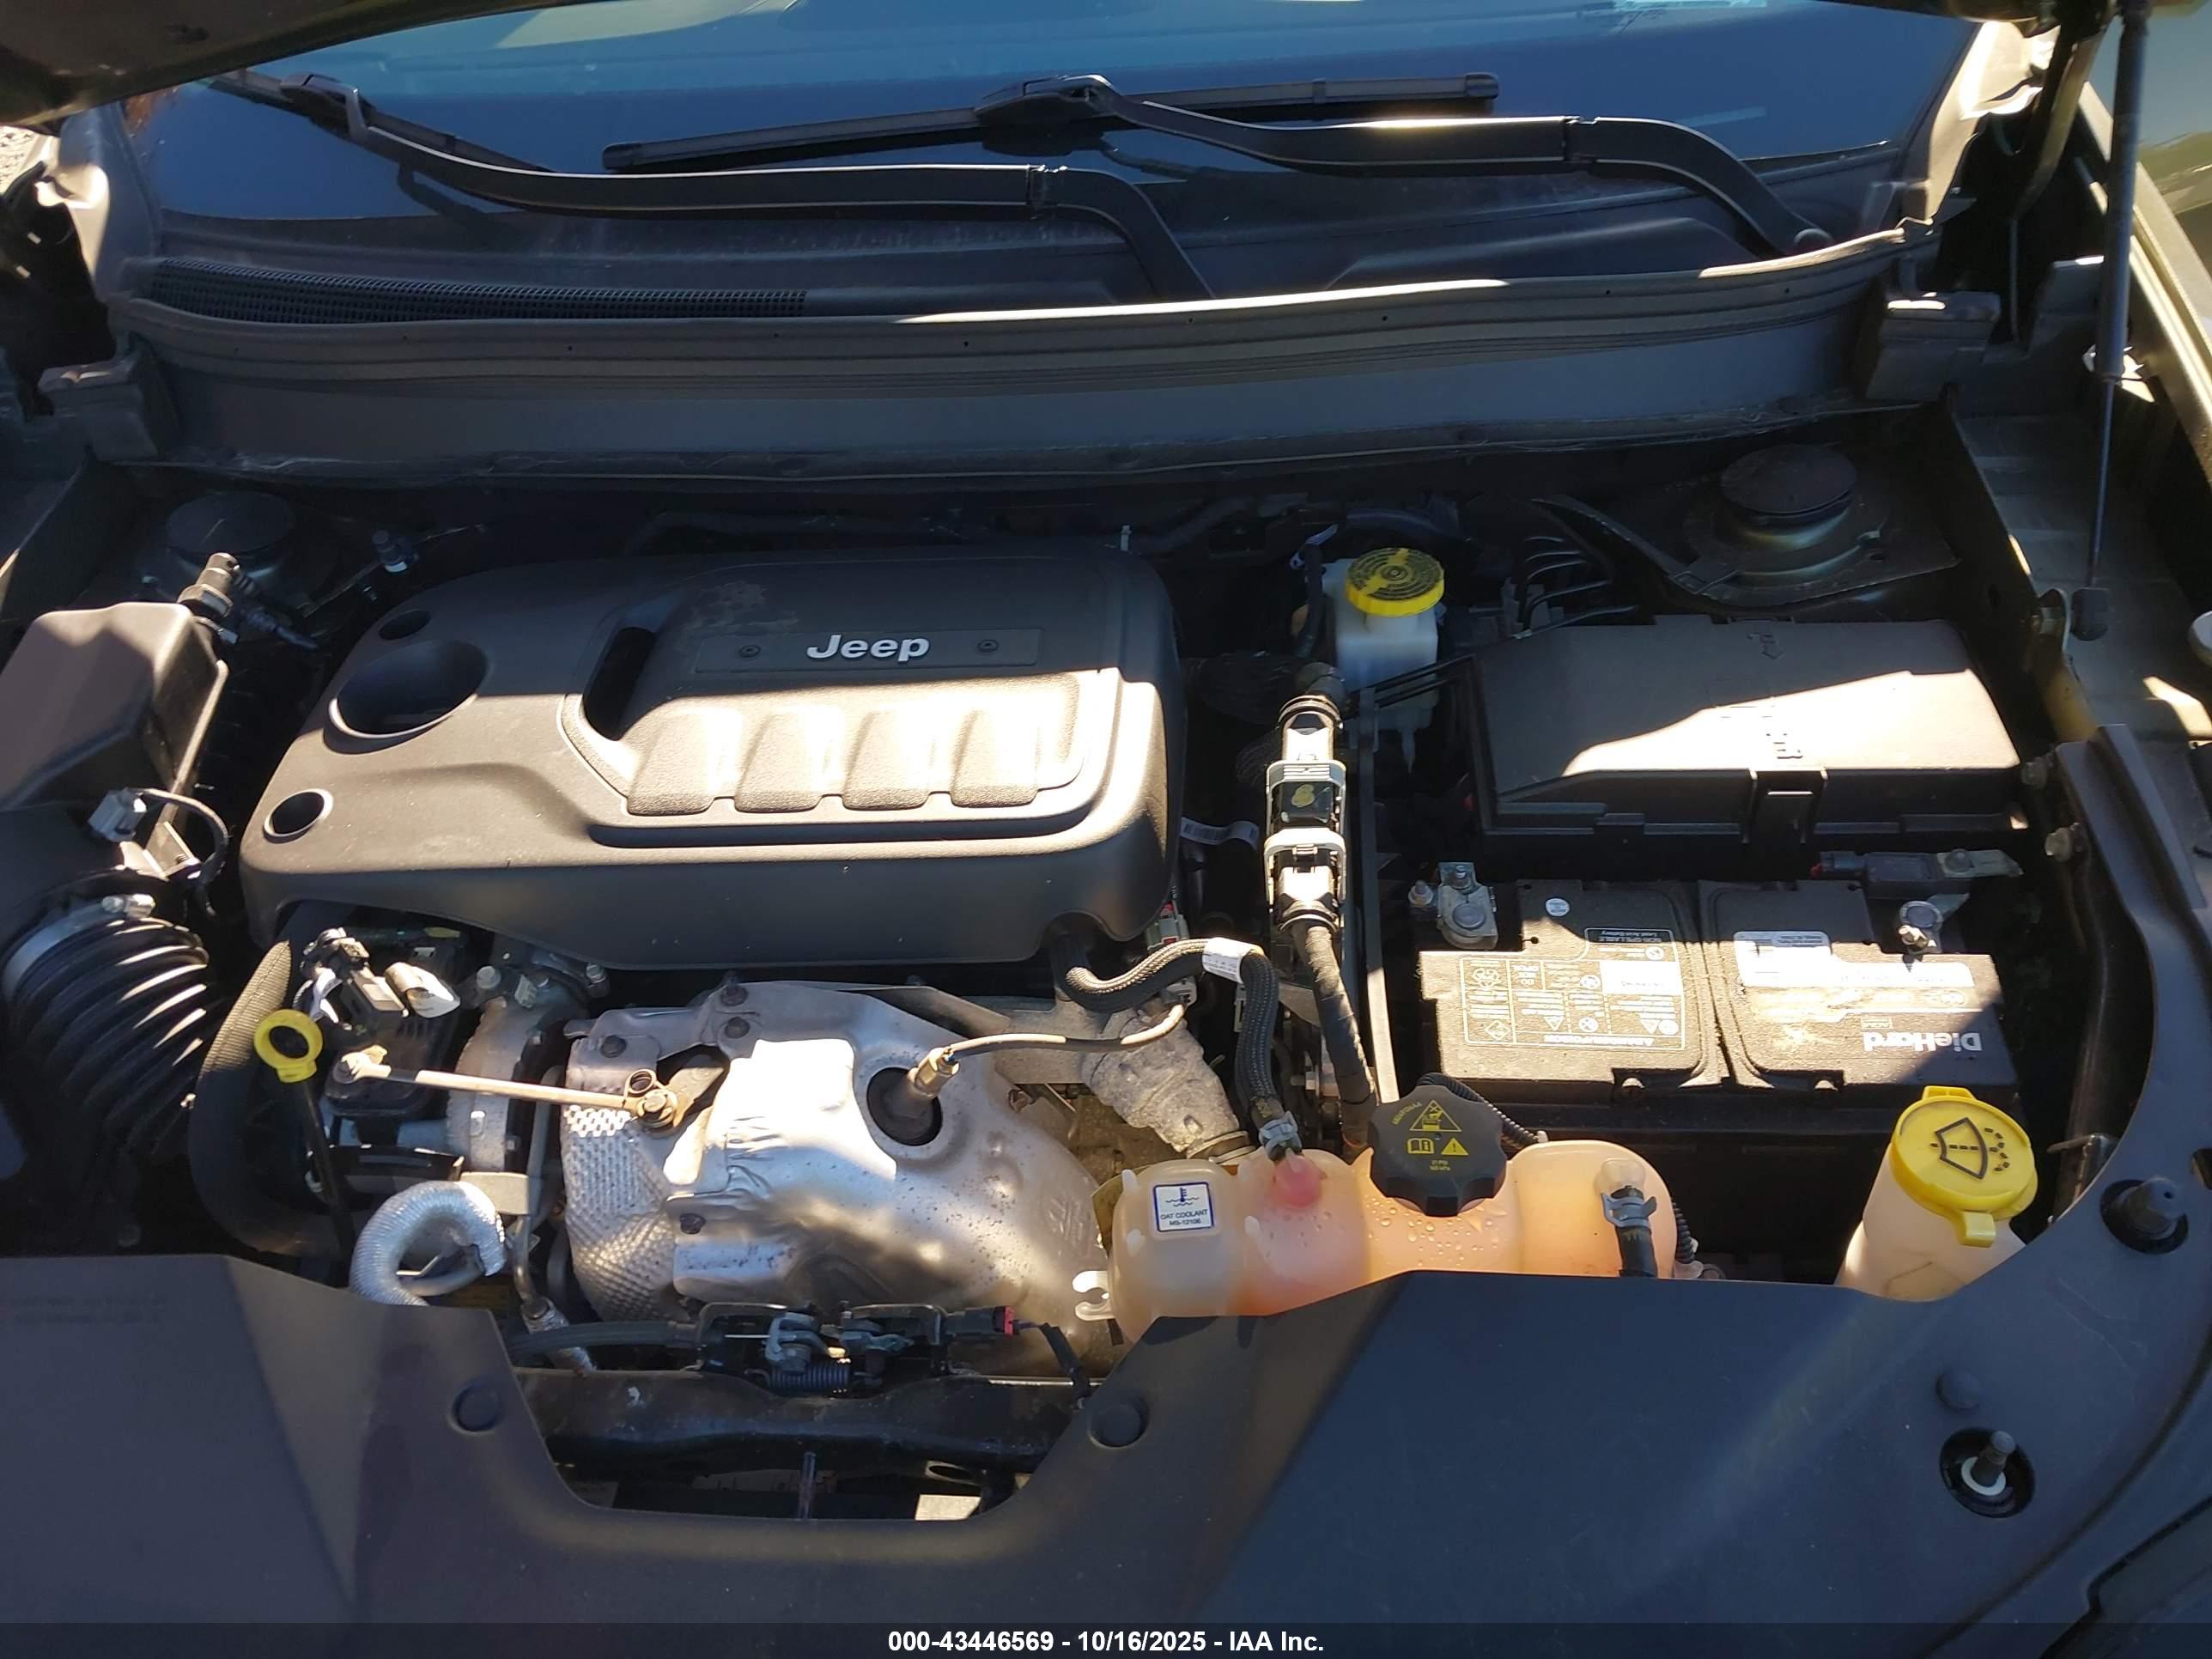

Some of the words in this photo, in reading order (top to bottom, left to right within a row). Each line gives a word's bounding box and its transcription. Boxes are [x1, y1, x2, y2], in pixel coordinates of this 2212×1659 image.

[806, 634, 930, 662] Jeep
[1863, 1031, 1983, 1052] DieHard
[1175, 1208, 1208, 1219] COOLANT
